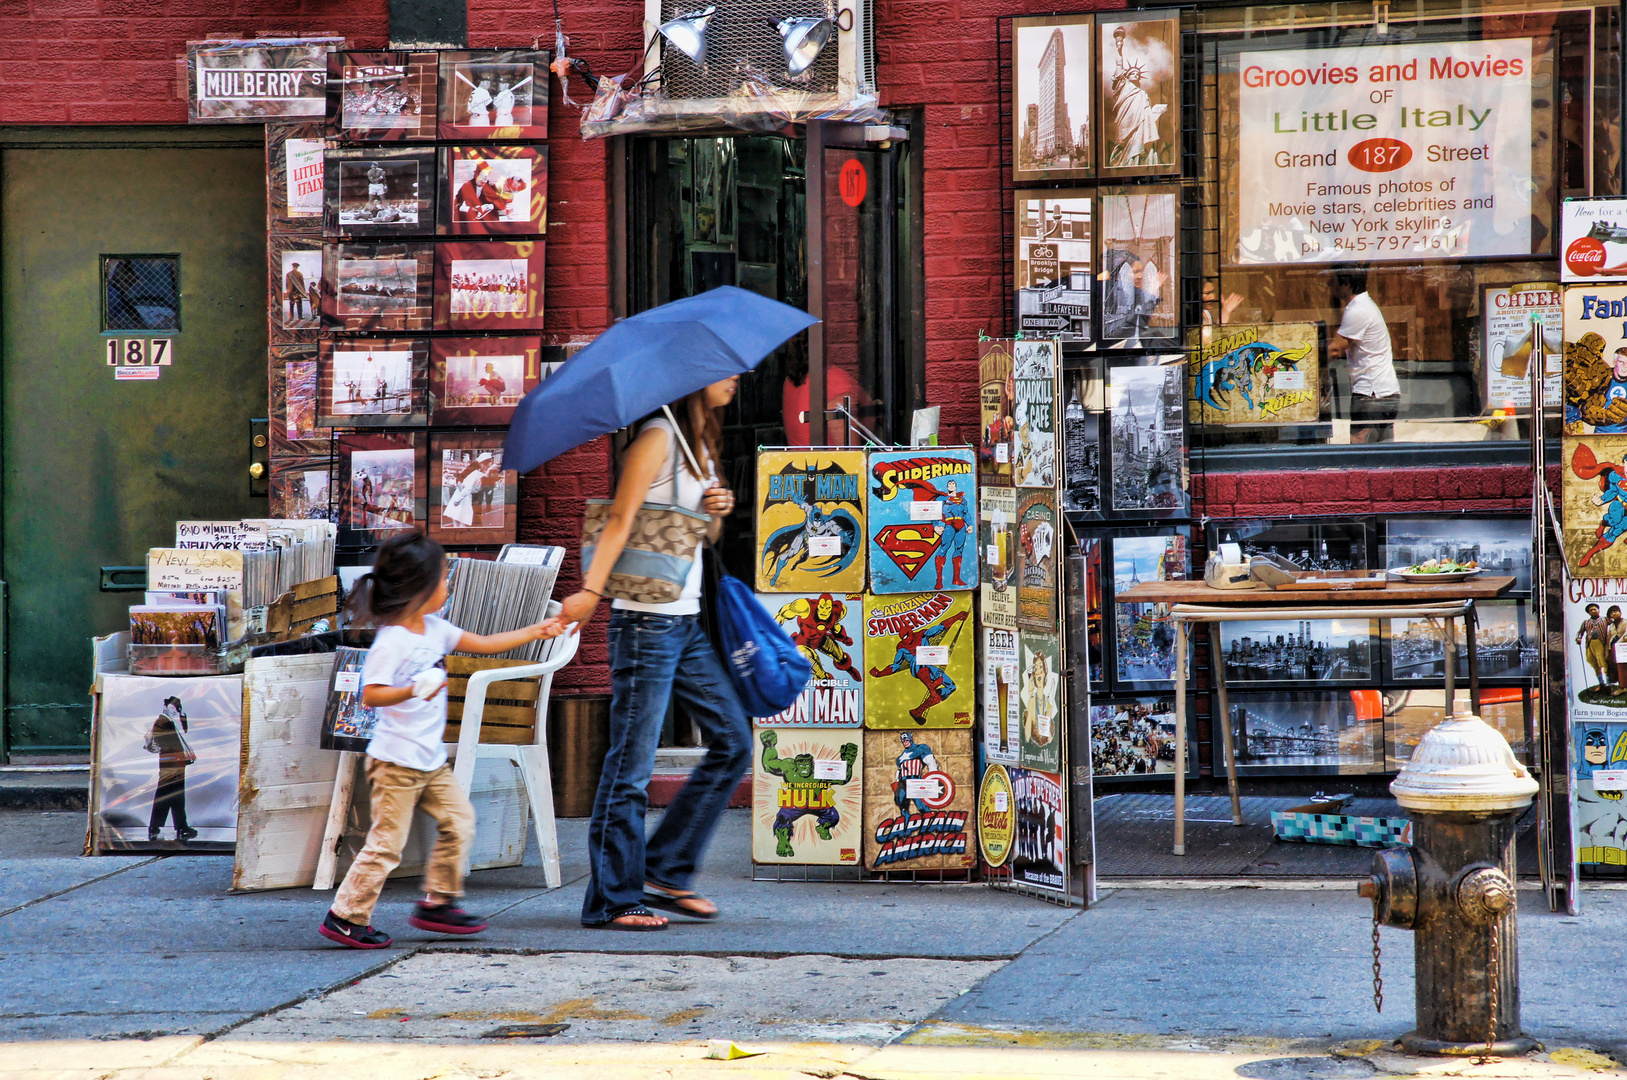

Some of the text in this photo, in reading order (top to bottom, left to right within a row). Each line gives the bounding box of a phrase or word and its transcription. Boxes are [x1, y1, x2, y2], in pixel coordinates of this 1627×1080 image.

[1243, 54, 1523, 87] Groovies and Movies
[207, 72, 327, 97] MULBERRY ST
[1369, 90, 1393, 104] OF
[1273, 105, 1492, 133] Little Italy
[1275, 143, 1489, 168] Grand 187 Street
[298, 177, 324, 196] ITALY
[845, 169, 861, 199] 187
[1307, 177, 1456, 202] Famous photos of
[1268, 195, 1494, 216] Movie stars, celebrities and
[1574, 205, 1594, 218] Now
[1599, 206, 1614, 216] for
[1309, 216, 1452, 233] New York skyline
[1333, 234, 1459, 252] 845-797-1611
[1050, 304, 1082, 316] LAFAYETTE
[1495, 291, 1562, 309] CHEER
[108, 340, 168, 364] 187
[1190, 326, 1258, 366] BATMAN
[1015, 380, 1053, 404] ROADKILL
[1260, 390, 1314, 420] ROBIN
[878, 460, 972, 501] SUPERMAN
[1026, 510, 1051, 521] CASINO
[1569, 578, 1609, 603] GOLF
[884, 592, 933, 617] AMAZING
[989, 633, 1015, 648] BEER
[813, 688, 859, 724] MAN
[1590, 710, 1605, 718] your
[777, 788, 836, 809] HULK
[875, 811, 969, 844] CAPTAIN
[873, 832, 967, 868] AMERICA
